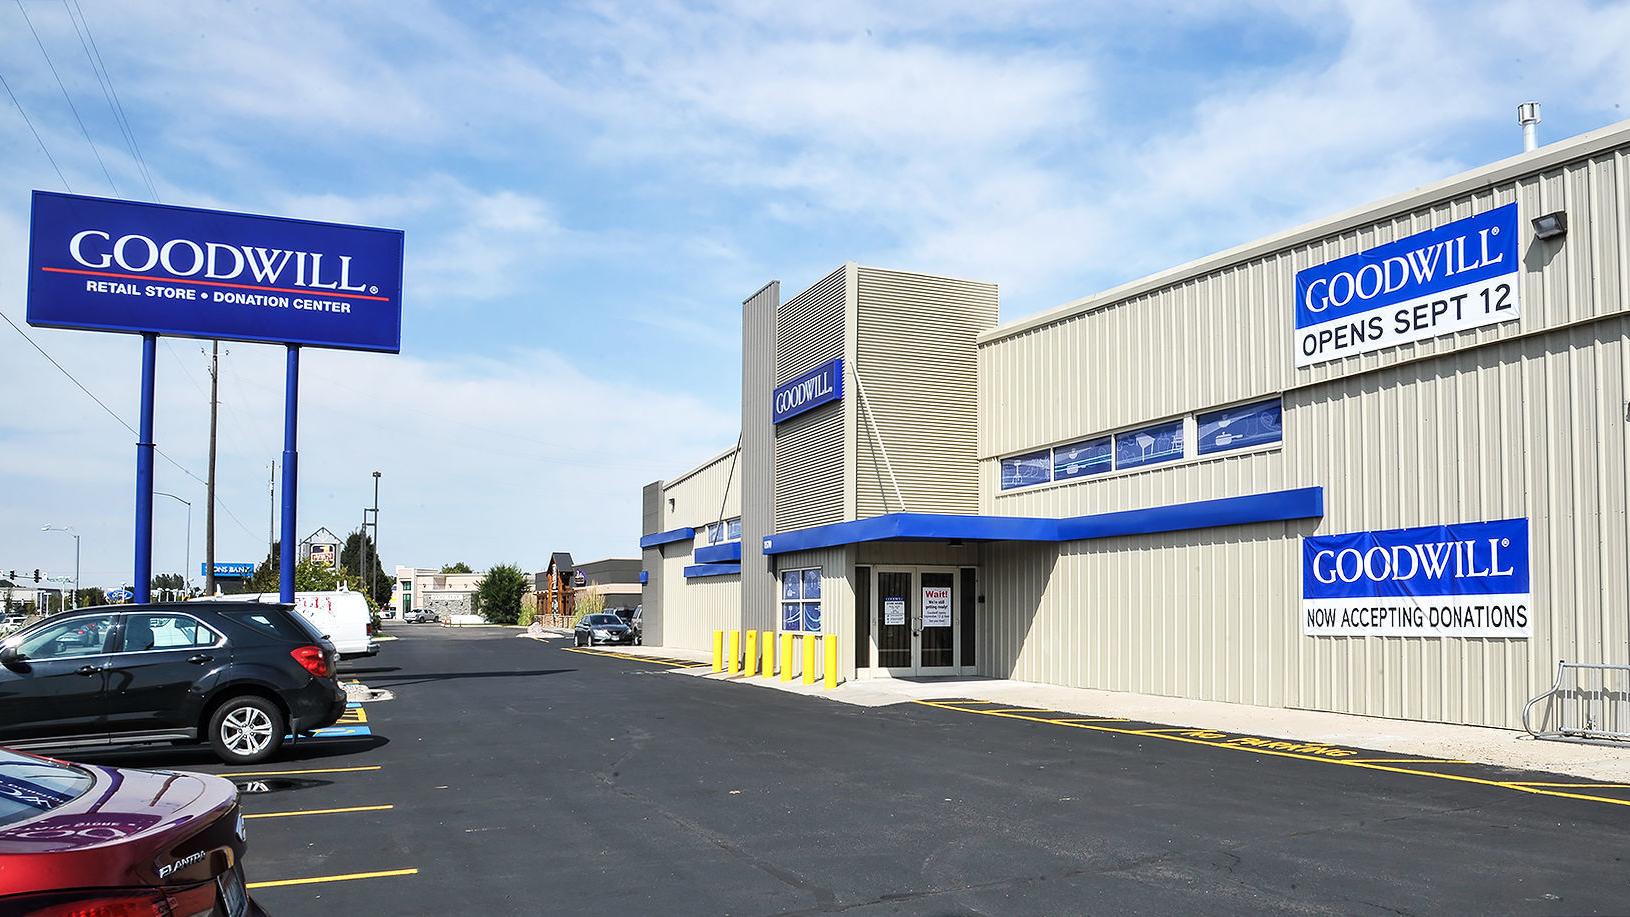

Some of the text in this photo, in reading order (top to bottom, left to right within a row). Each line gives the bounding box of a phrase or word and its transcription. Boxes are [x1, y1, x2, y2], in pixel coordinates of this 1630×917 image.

[69, 230, 367, 293] GOODWILL
[1306, 228, 1503, 313] GOODWILL
[86, 280, 351, 314] RETAIL STORE DONATION CENTER
[1302, 283, 1512, 356] OPENS SEPT 12
[776, 372, 830, 414] GOODWILL
[1313, 538, 1514, 584] GOODWILL
[925, 590, 948, 598] Wait!
[1307, 604, 1528, 628] NOW ACCEPTING DONATIONS
[1226, 737, 1358, 757] PARKING
[159, 850, 206, 879] ELANTRA
